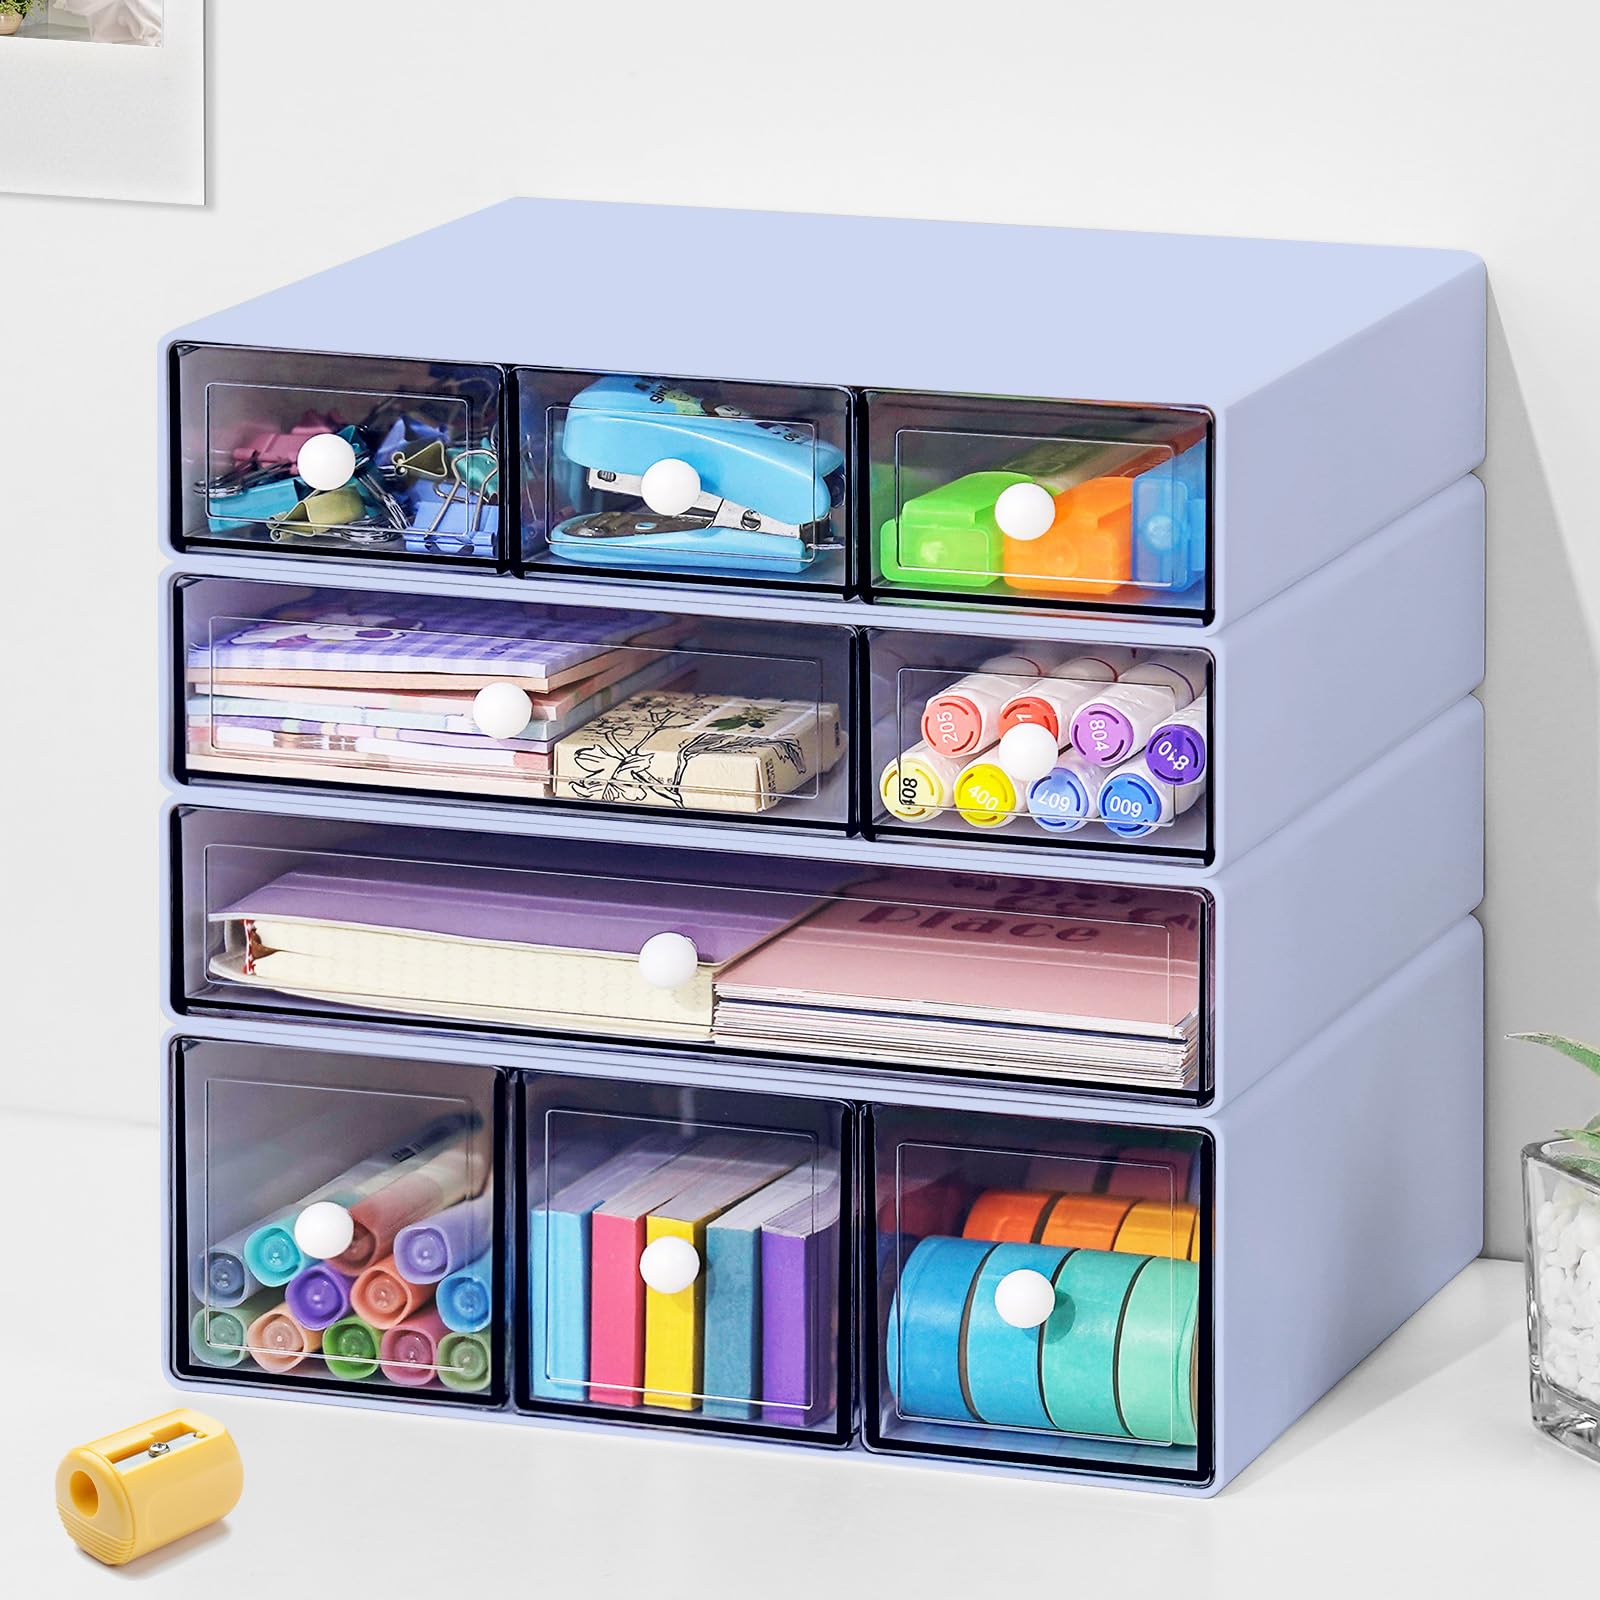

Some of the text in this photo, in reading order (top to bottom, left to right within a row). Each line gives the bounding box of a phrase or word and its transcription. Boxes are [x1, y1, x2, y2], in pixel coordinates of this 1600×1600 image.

[936, 711, 960, 743] 205
[1089, 718, 1110, 752] 804
[967, 785, 999, 811] 400
